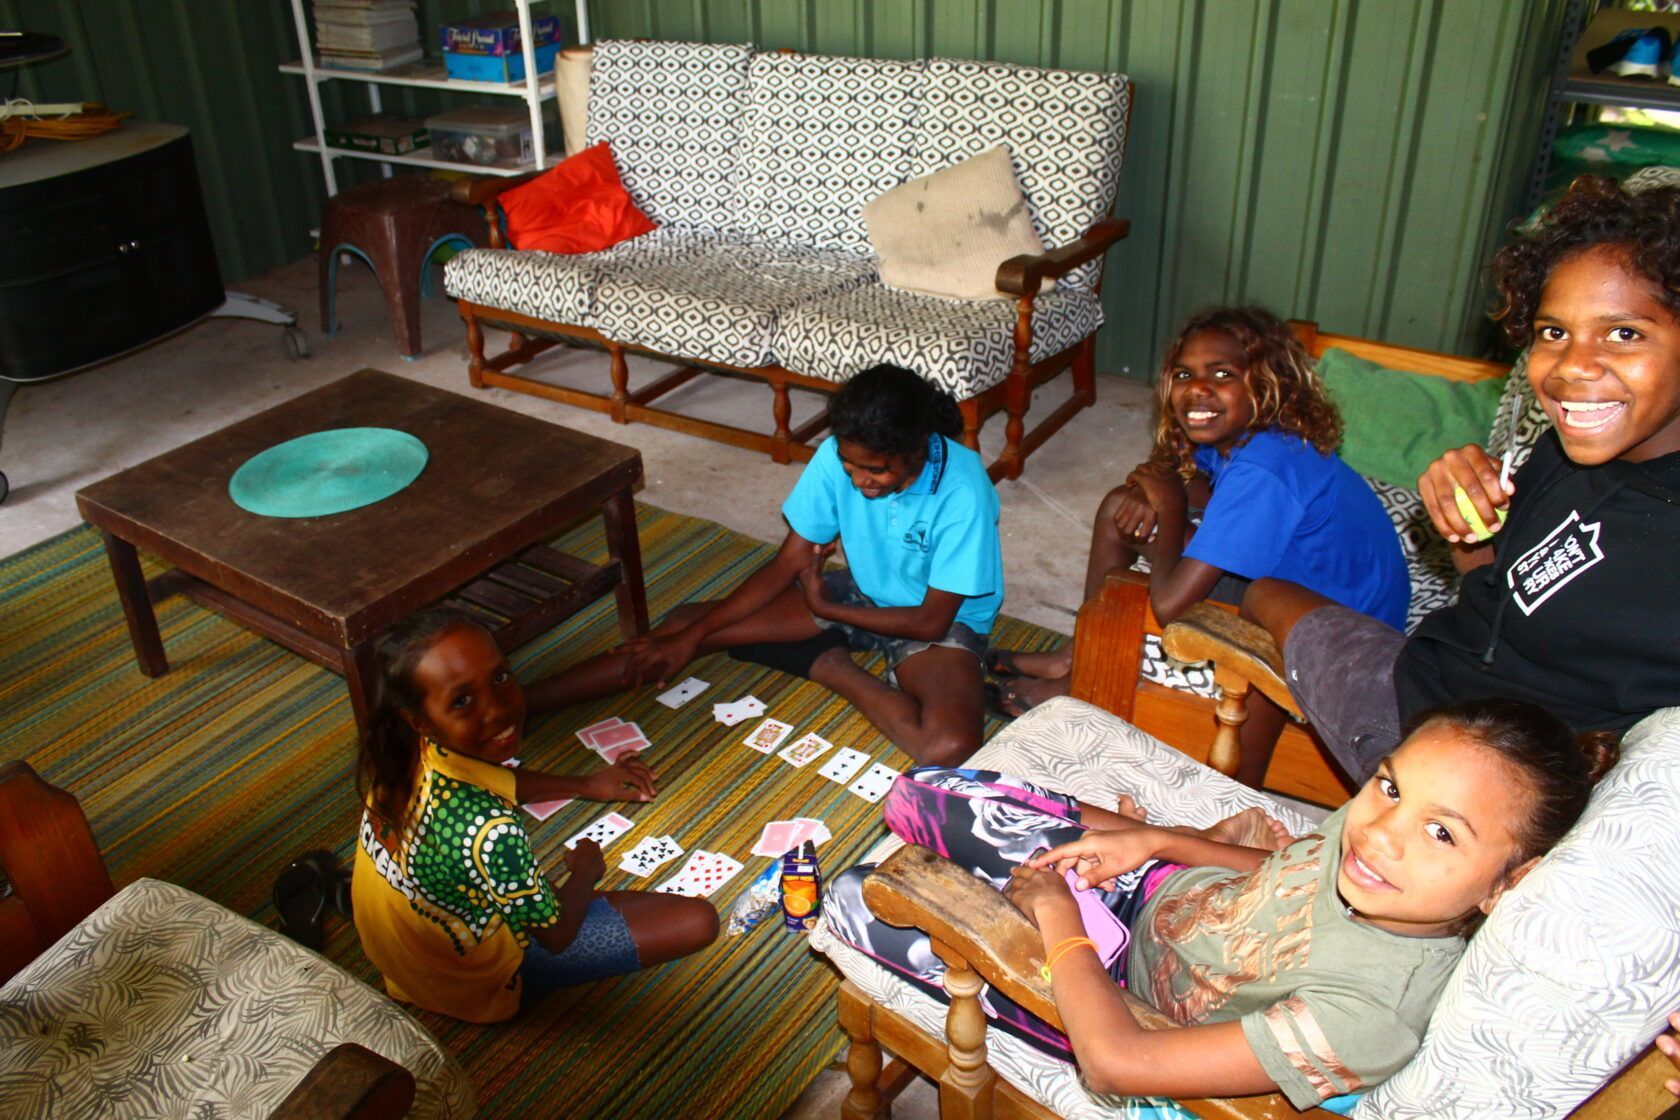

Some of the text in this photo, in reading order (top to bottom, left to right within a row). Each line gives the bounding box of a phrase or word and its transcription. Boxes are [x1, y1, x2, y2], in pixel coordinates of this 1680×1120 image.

[1564, 534, 1586, 564] ON'T
[360, 808, 416, 901] CKERS
[1270, 833, 1326, 983] CUTE
